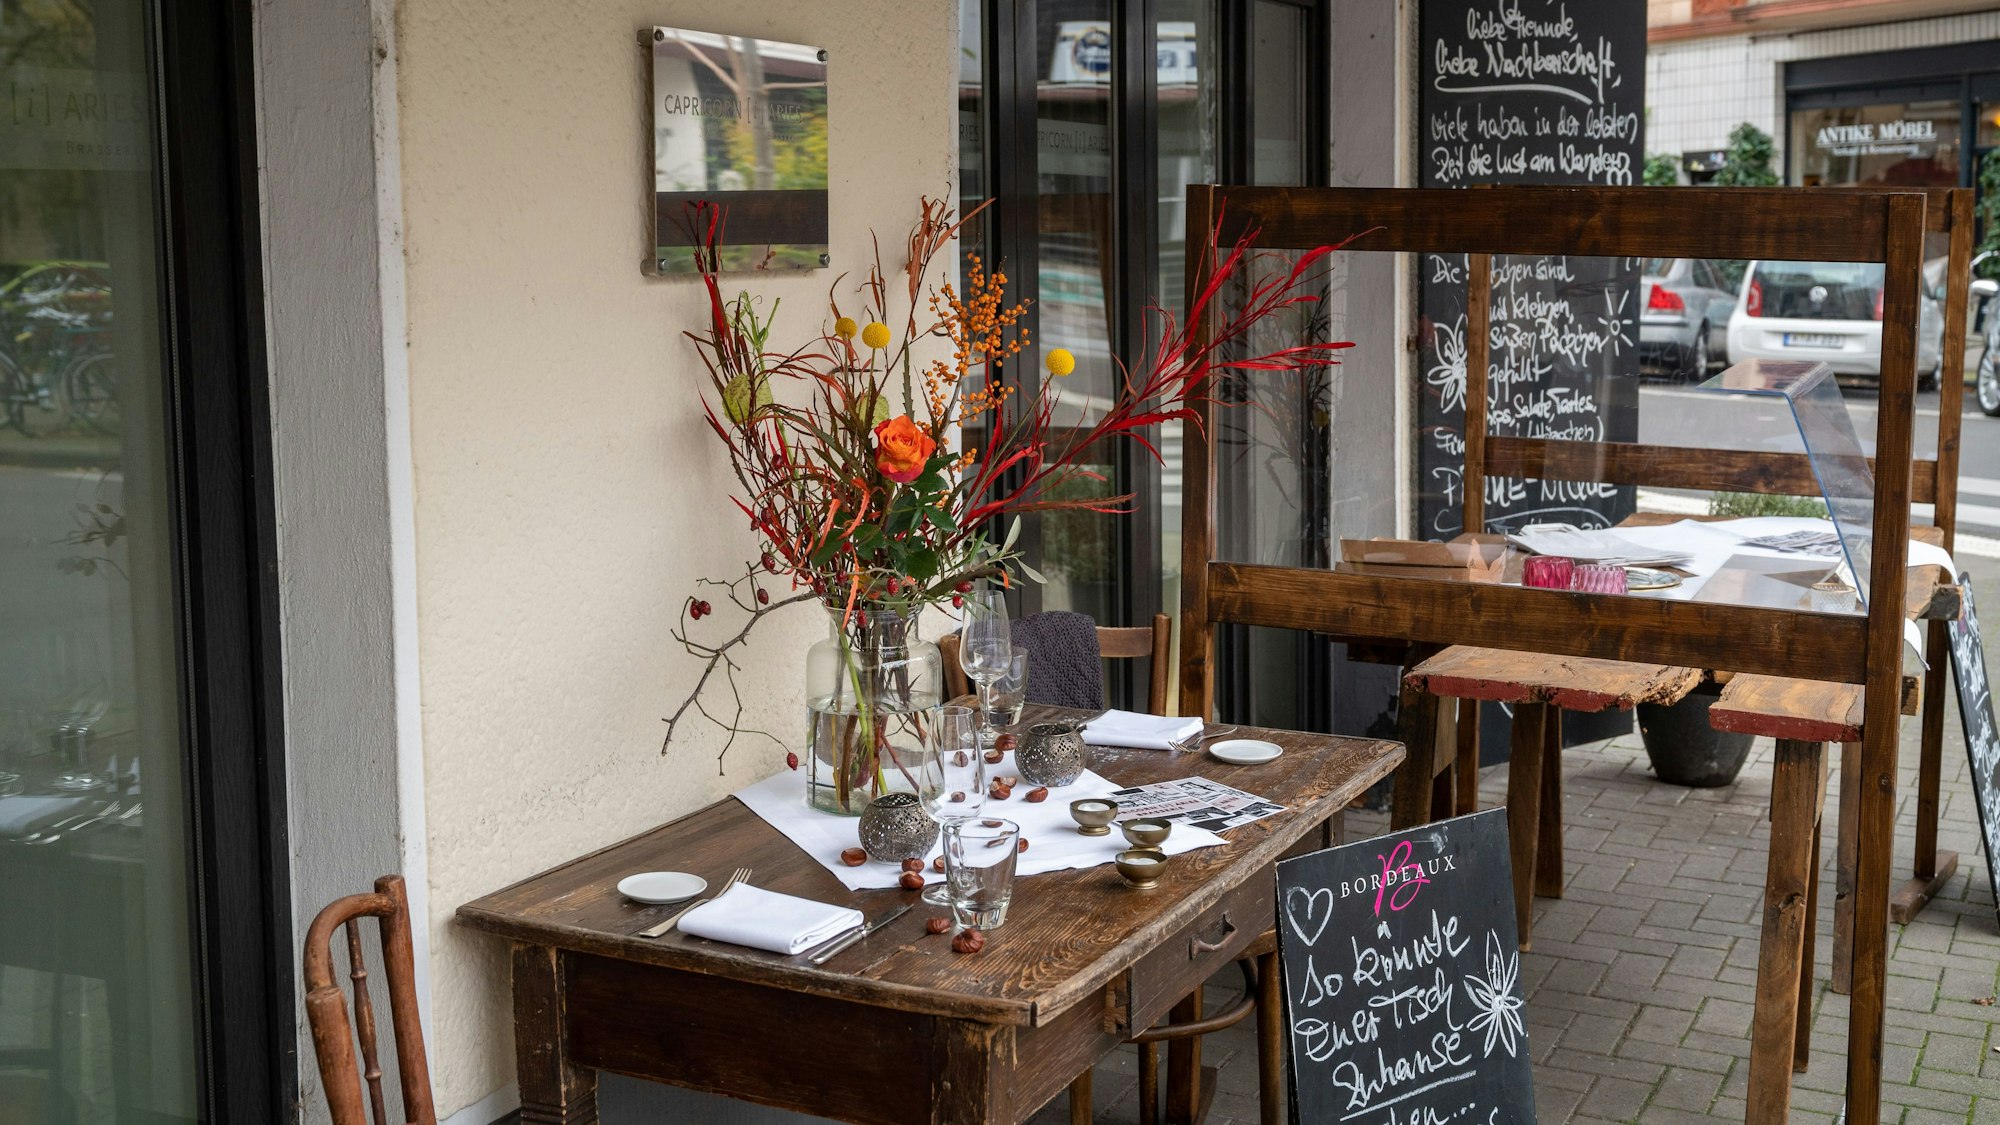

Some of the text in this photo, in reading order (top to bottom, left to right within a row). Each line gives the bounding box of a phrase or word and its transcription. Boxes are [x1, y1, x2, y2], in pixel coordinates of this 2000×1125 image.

[664, 94, 743, 120] CAPRICORN
[768, 104, 803, 124] ARIES
[1534, 106, 1550, 137] in
[1557, 105, 1580, 137] der
[1816, 119, 1937, 146] ANTIKE MÖBEL
[1530, 150, 1555, 173] am
[1429, 254, 1461, 284] Die
[1340, 854, 1457, 899] BORDEAUX
